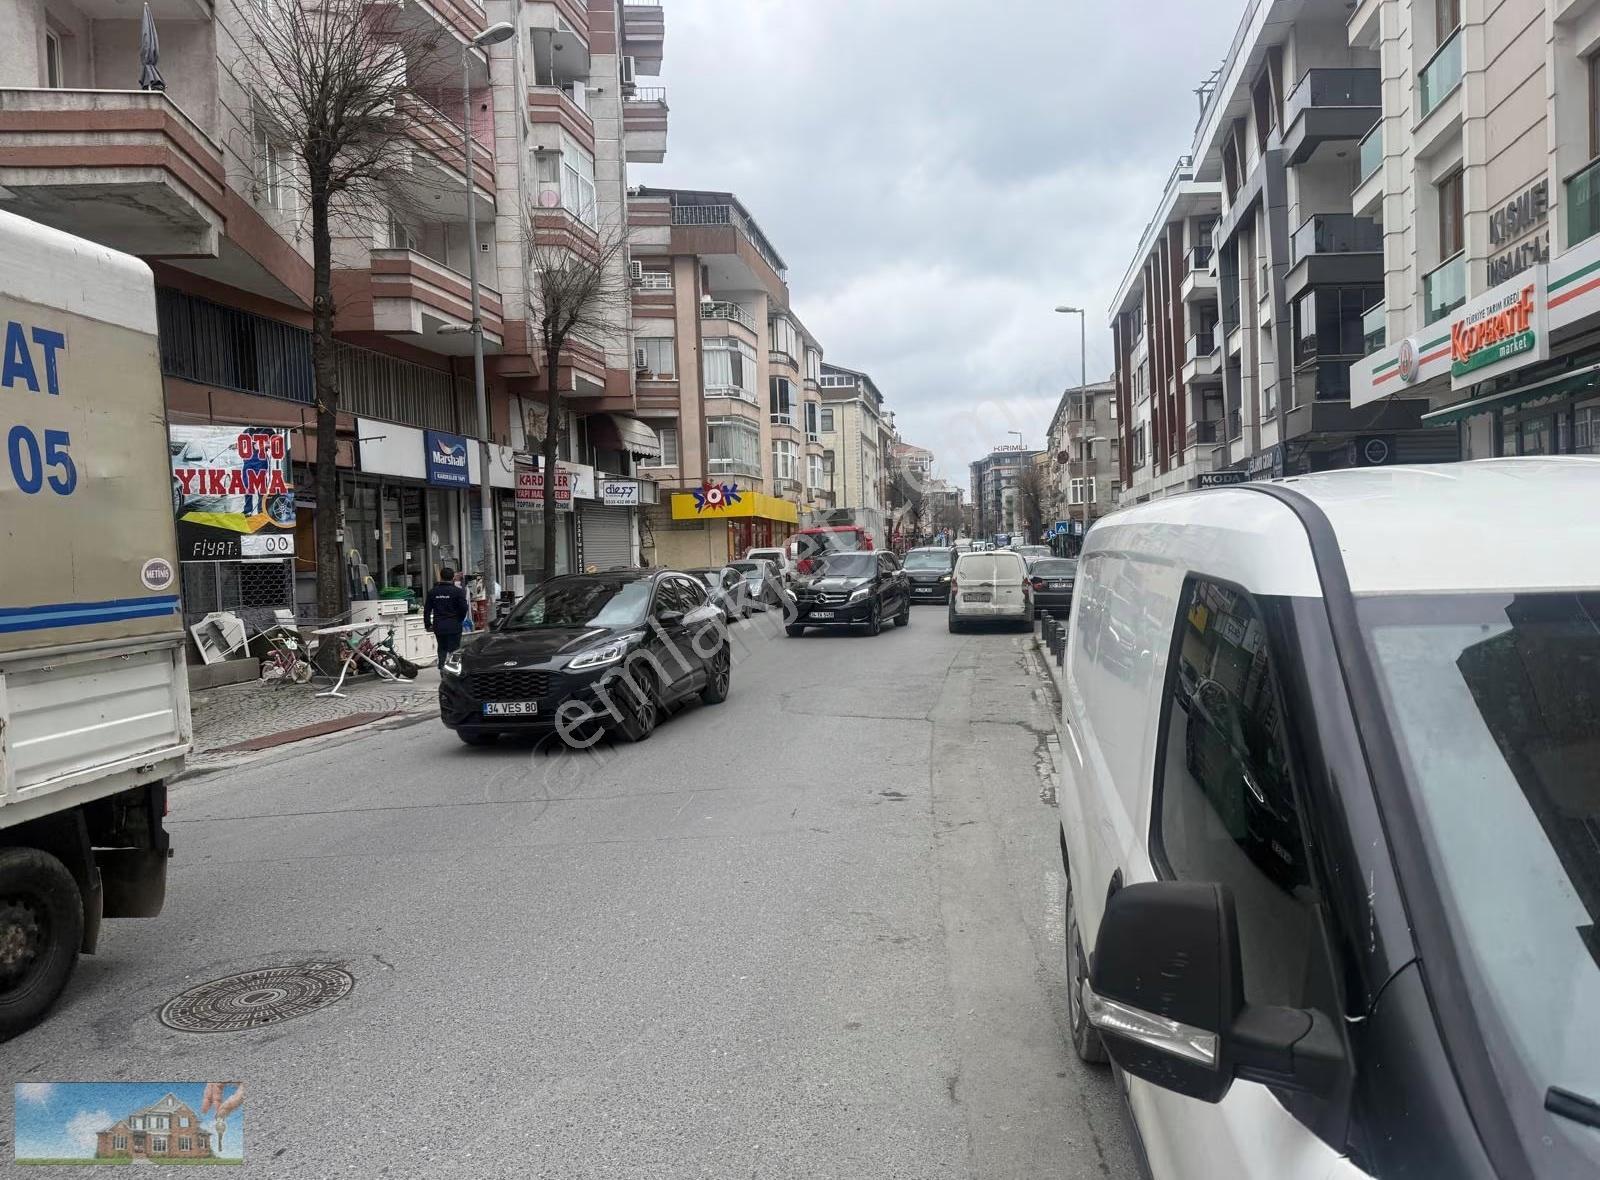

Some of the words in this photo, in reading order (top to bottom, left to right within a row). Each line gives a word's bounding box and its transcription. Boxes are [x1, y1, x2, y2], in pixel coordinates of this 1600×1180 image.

[1486, 301, 1502, 316] TARIM
[1499, 335, 1527, 357] market
[1, 320, 65, 396] AT
[237, 433, 285, 460] OTO
[7, 425, 78, 496] 05
[432, 450, 465, 467] Marshall
[175, 468, 289, 496] YIKAMA
[519, 474, 568, 487] KARDLER
[1201, 474, 1241, 484] MODA
[517, 489, 530, 498] YAPI
[531, 489, 570, 499] MALELERİ
[487, 703, 498, 713] 34
[501, 703, 522, 713] VES
[525, 702, 537, 712] 80
